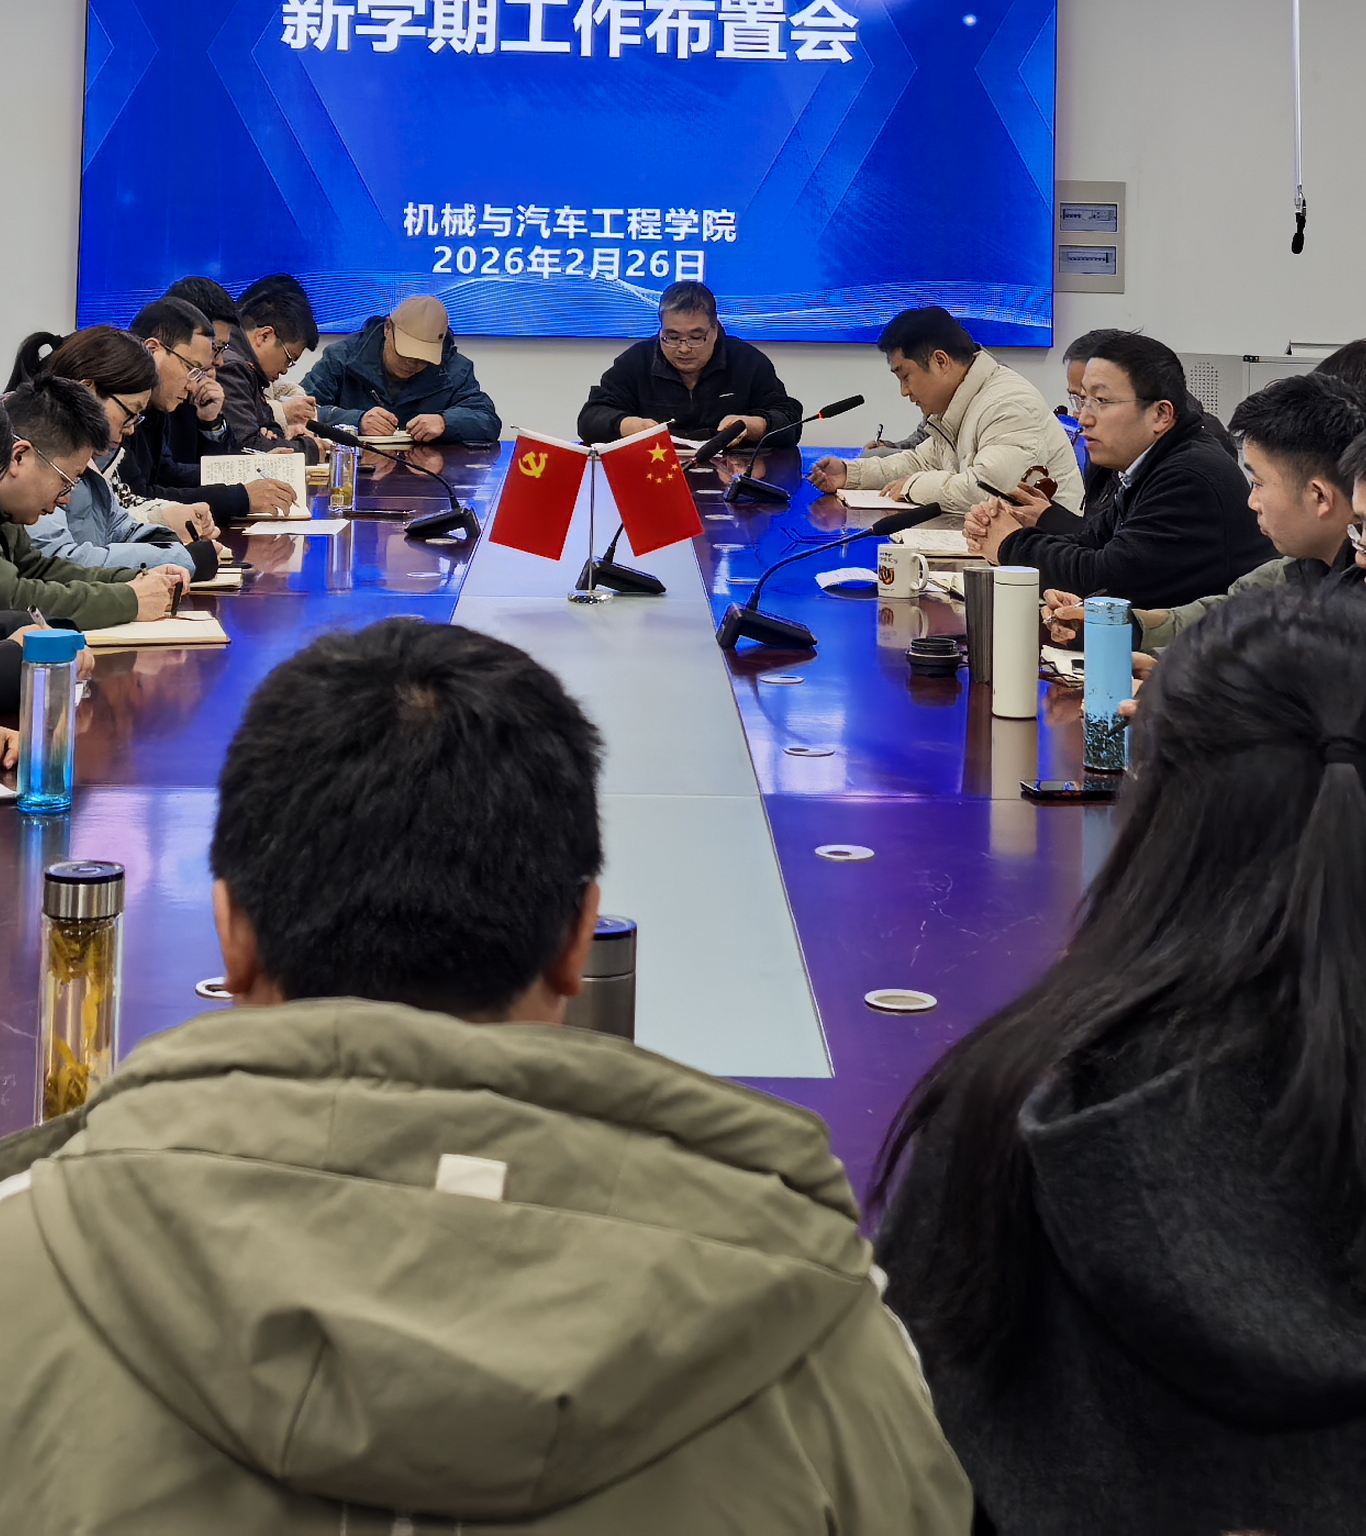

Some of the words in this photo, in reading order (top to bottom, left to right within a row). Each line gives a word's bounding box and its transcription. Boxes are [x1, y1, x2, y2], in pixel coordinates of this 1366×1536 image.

[403, 201, 737, 243] 机械与汽车工程学院
[432, 245, 706, 283] 2026年2月26日
